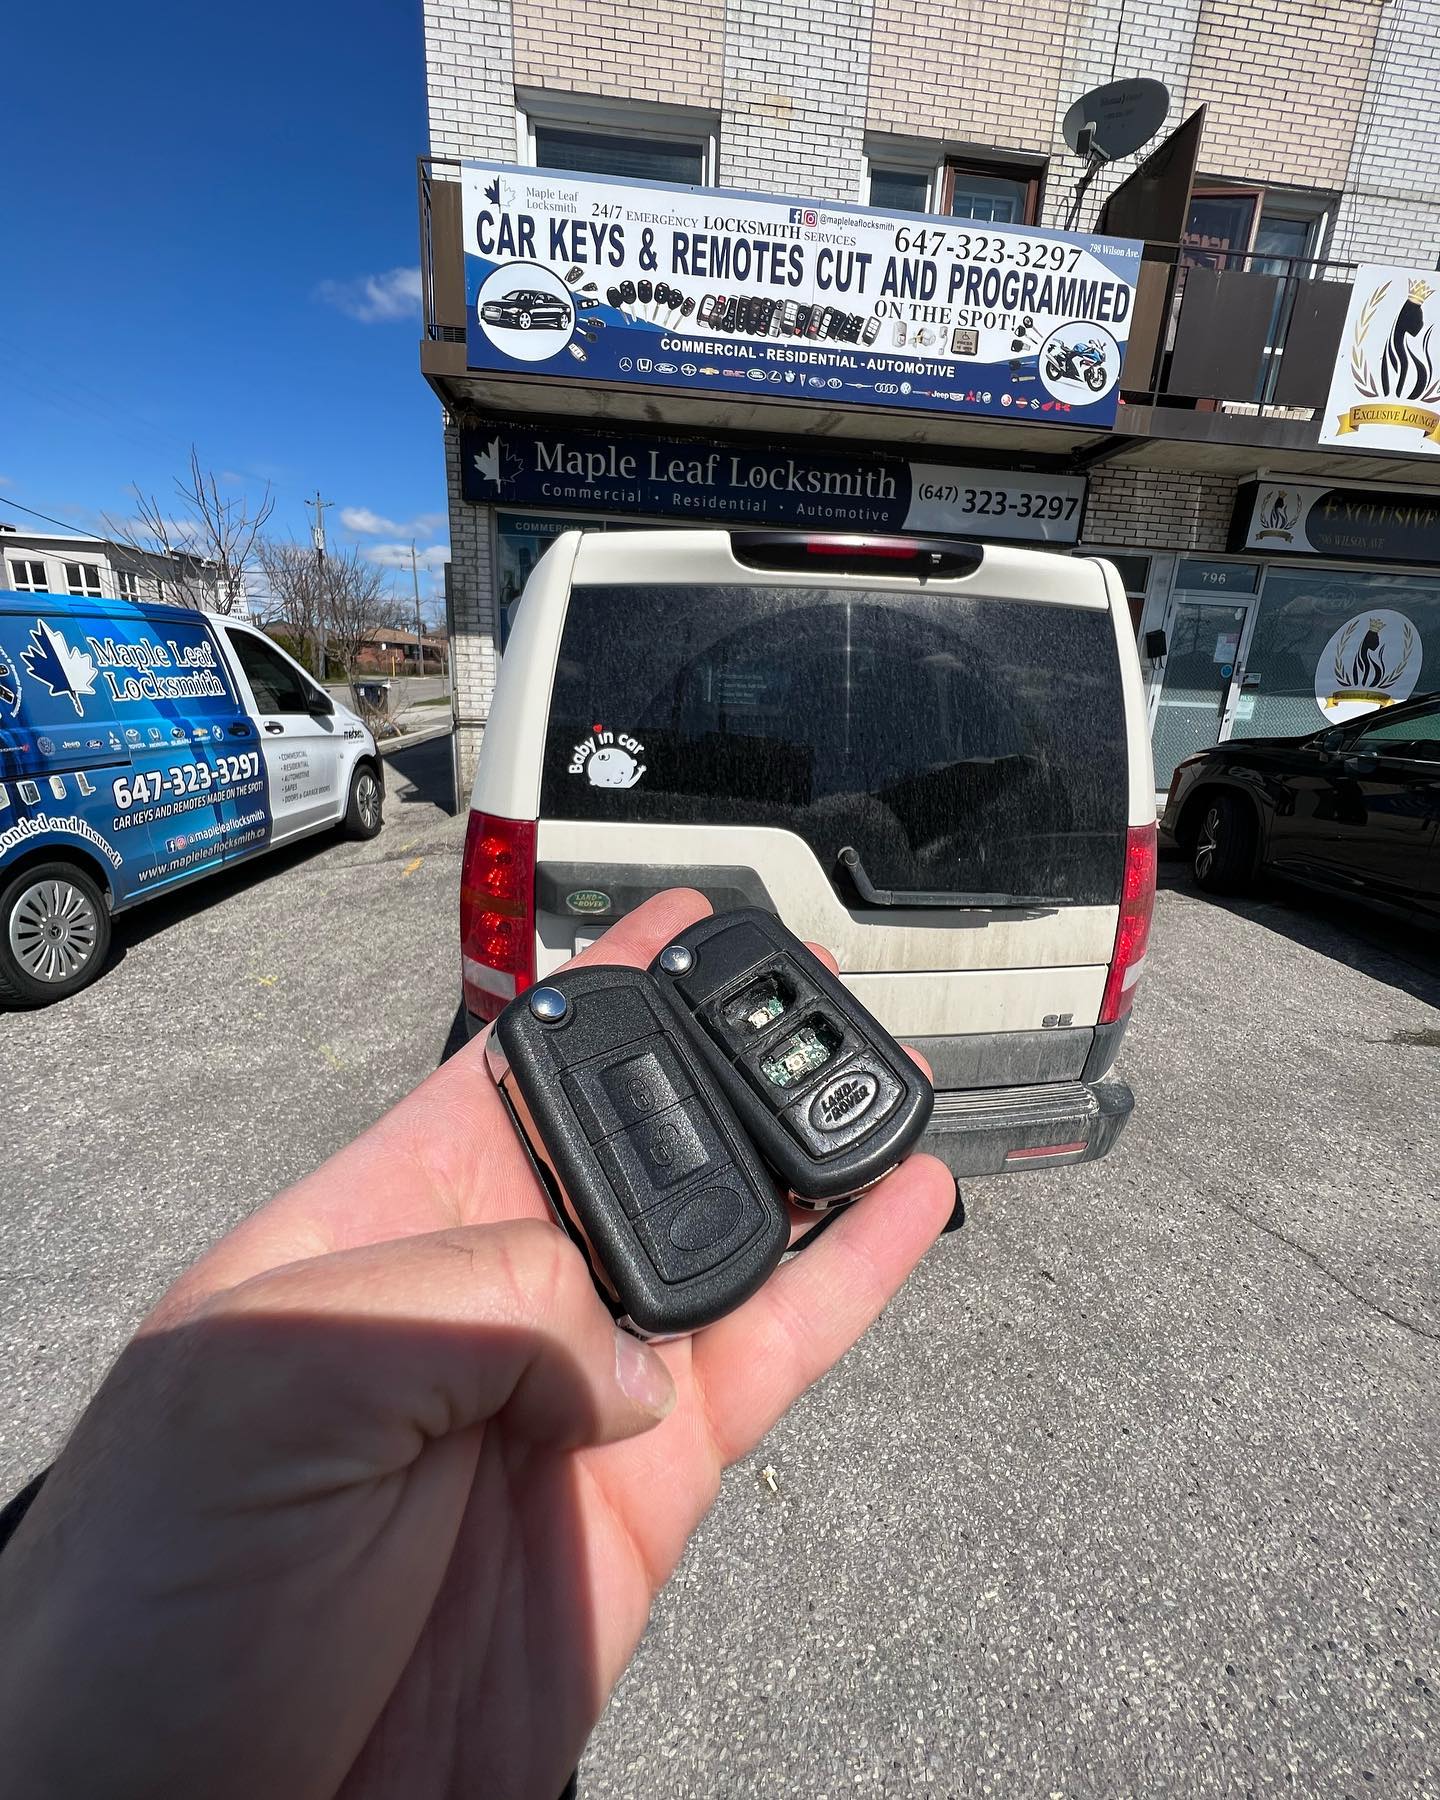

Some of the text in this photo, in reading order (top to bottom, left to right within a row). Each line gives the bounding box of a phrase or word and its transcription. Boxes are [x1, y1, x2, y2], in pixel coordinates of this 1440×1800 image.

[526, 187, 579, 202] Maple Leaf
[526, 199, 577, 214] Locksmith
[592, 203, 857, 247] 24/7 EMERGENCY LOCKSMITH SERVICES
[820, 214, 895, 232] @mapleleaflocksmith
[476, 210, 1130, 323] CAR KEYS & REMOTES CUT AND PROGRAMMED
[894, 226, 1083, 274] 647-323-3297
[1089, 243, 1141, 259] 798 Wilson Ave.
[874, 299, 1018, 332] ON THE SPOT!
[660, 338, 757, 359] COMMERCIAL
[766, 349, 857, 369] RESIDENTIAL
[867, 358, 955, 377] AUTOMOTIVE
[931, 390, 949, 400] Jeep
[534, 441, 897, 500] Maple Leaf Locksmith
[541, 483, 889, 522] Commercial Residential Automotive
[918, 482, 1079, 521] (647) 323-3297
[1201, 572, 1226, 585] 796
[86, 638, 217, 672] Maple Leaf
[103, 670, 226, 701] Locksmith
[568, 732, 645, 774] Baby in car
[112, 752, 260, 810] 647-323-3297
[113, 780, 264, 831] CAR KEYS AND REMOTES MADE ON THE SPOT!
[49, 816, 79, 834] and
[79, 819, 123, 869] Insured!
[187, 810, 265, 843] @mapleleaflocksmith
[138, 827, 266, 882] www.mapleleaflocksmith.ca
[1041, 1013, 1073, 1027] SE
